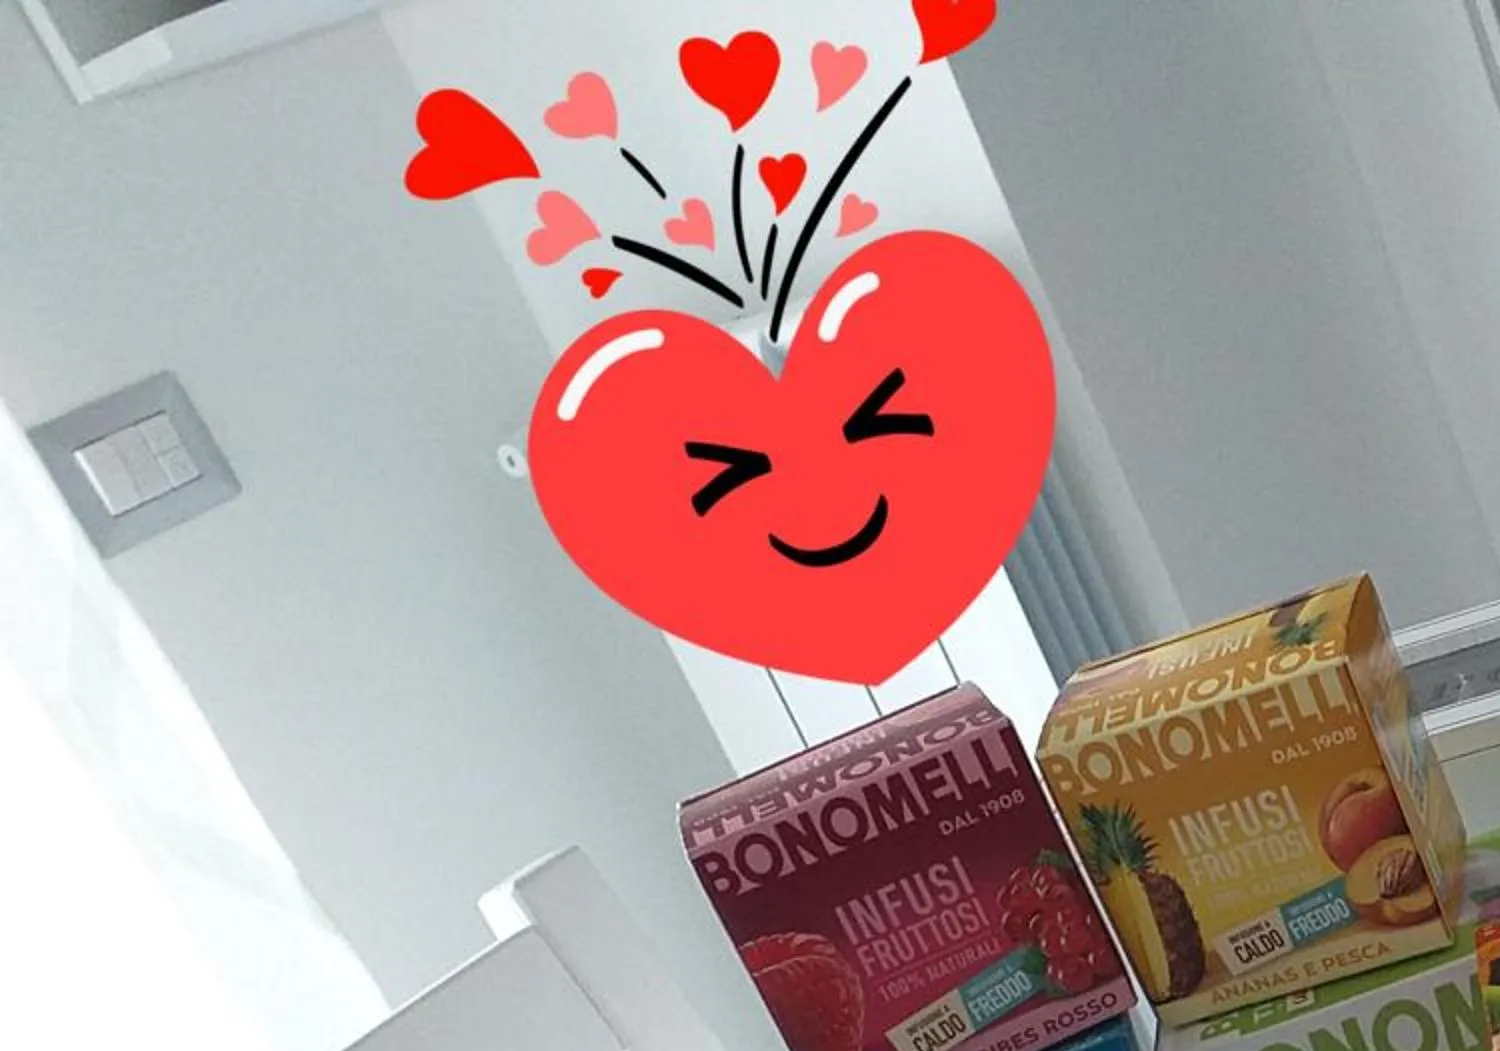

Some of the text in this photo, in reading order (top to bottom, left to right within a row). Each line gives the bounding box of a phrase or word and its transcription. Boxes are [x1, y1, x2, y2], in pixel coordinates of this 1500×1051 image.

[1041, 664, 1359, 796] BONOMELLI
[1271, 726, 1358, 764] DAL 1908
[693, 726, 1020, 894] BONOMELLI
[938, 788, 1025, 835] DAL 1908
[1168, 785, 1299, 856] INFUSI
[1187, 825, 1314, 887] FRUTTOSI
[835, 855, 974, 944] INFUSI
[1289, 897, 1350, 940] FREDDO
[856, 900, 990, 977] FRUTTOSI
[878, 970, 927, 1002] 100%
[926, 936, 1002, 981] NATURALI
[1233, 929, 1285, 964] CALDO
[968, 969, 1033, 1022] FREDDO
[1212, 940, 1392, 1004] ANANAS E PESCA
[1044, 991, 1118, 1034] ROSSO
